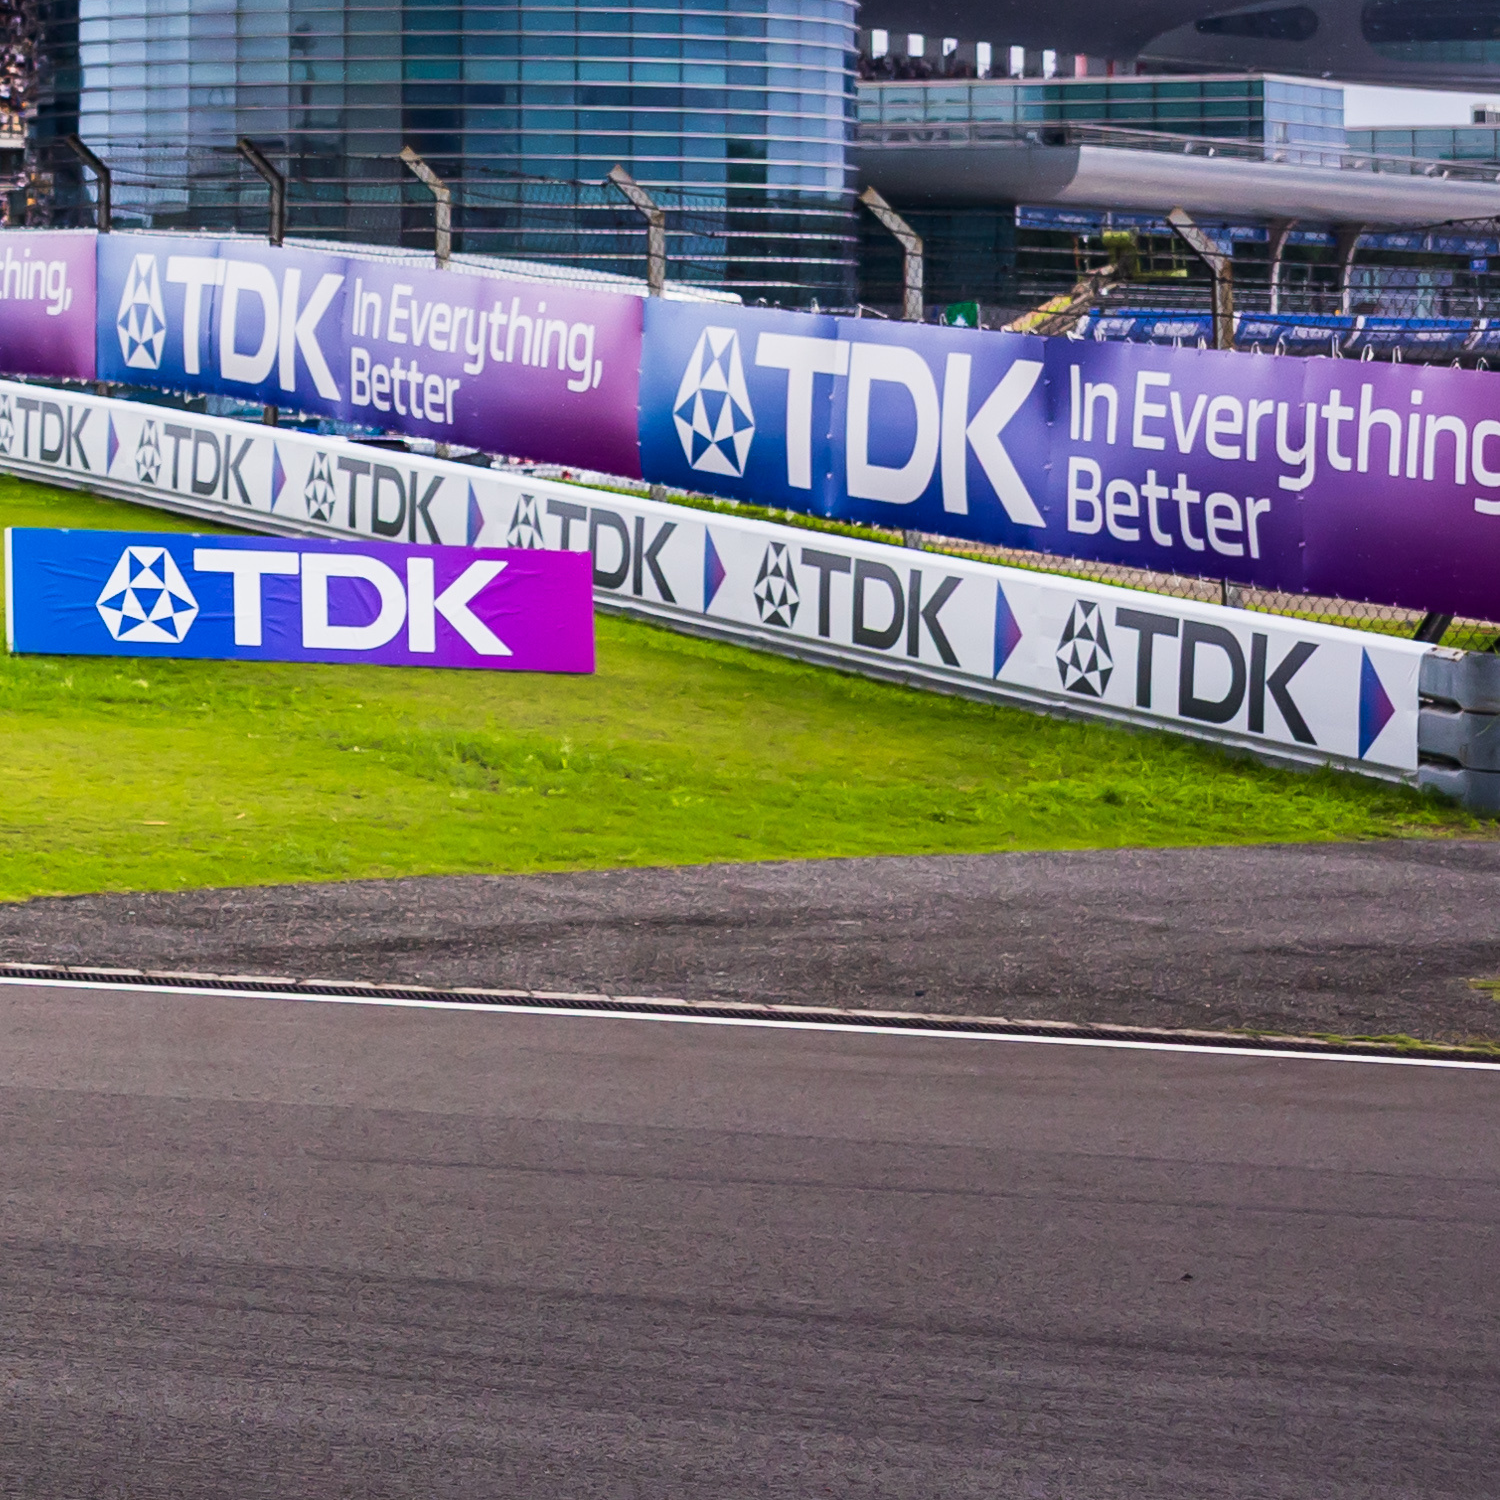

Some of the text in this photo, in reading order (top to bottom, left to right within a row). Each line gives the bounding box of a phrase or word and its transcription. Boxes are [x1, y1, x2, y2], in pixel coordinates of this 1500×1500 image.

[166, 255, 603, 401] TDK In Everything,
[15, 396, 93, 471] TDK
[350, 347, 460, 425] Better
[755, 331, 1047, 528] TDK
[1069, 364, 1118, 445] In
[163, 423, 255, 506] TDK
[337, 457, 445, 546] TDK
[1067, 456, 1271, 559] Better
[193, 548, 514, 656] TDK
[547, 499, 678, 604] TDK
[801, 548, 964, 668] TDK
[1115, 607, 1320, 746] TDK
